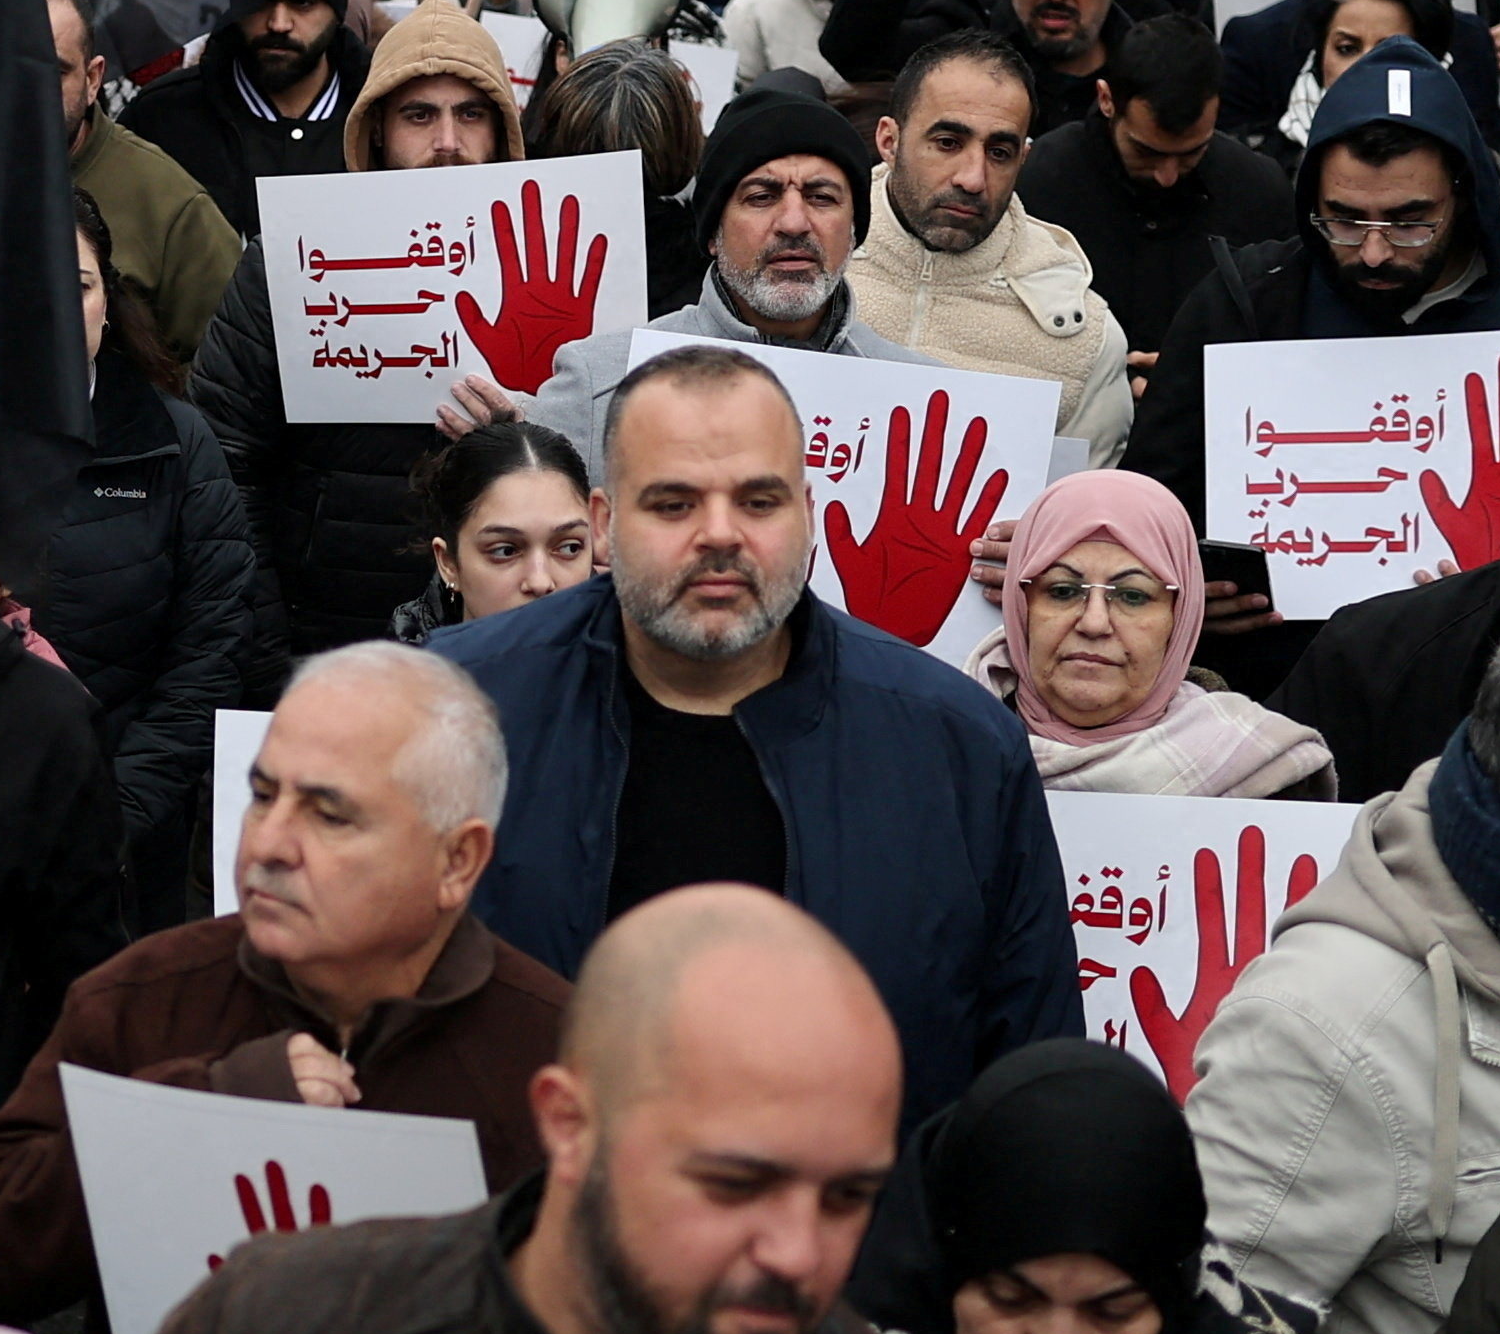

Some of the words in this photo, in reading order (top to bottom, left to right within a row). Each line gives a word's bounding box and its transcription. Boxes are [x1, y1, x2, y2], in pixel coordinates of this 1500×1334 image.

[298, 215, 477, 284] أوقفوا
[303, 289, 446, 328] حرب
[309, 328, 460, 380] الجريمة
[1245, 388, 1448, 459] أوقفوا
[1245, 467, 1409, 508] حرب
[1247, 509, 1421, 567] الجريمة
